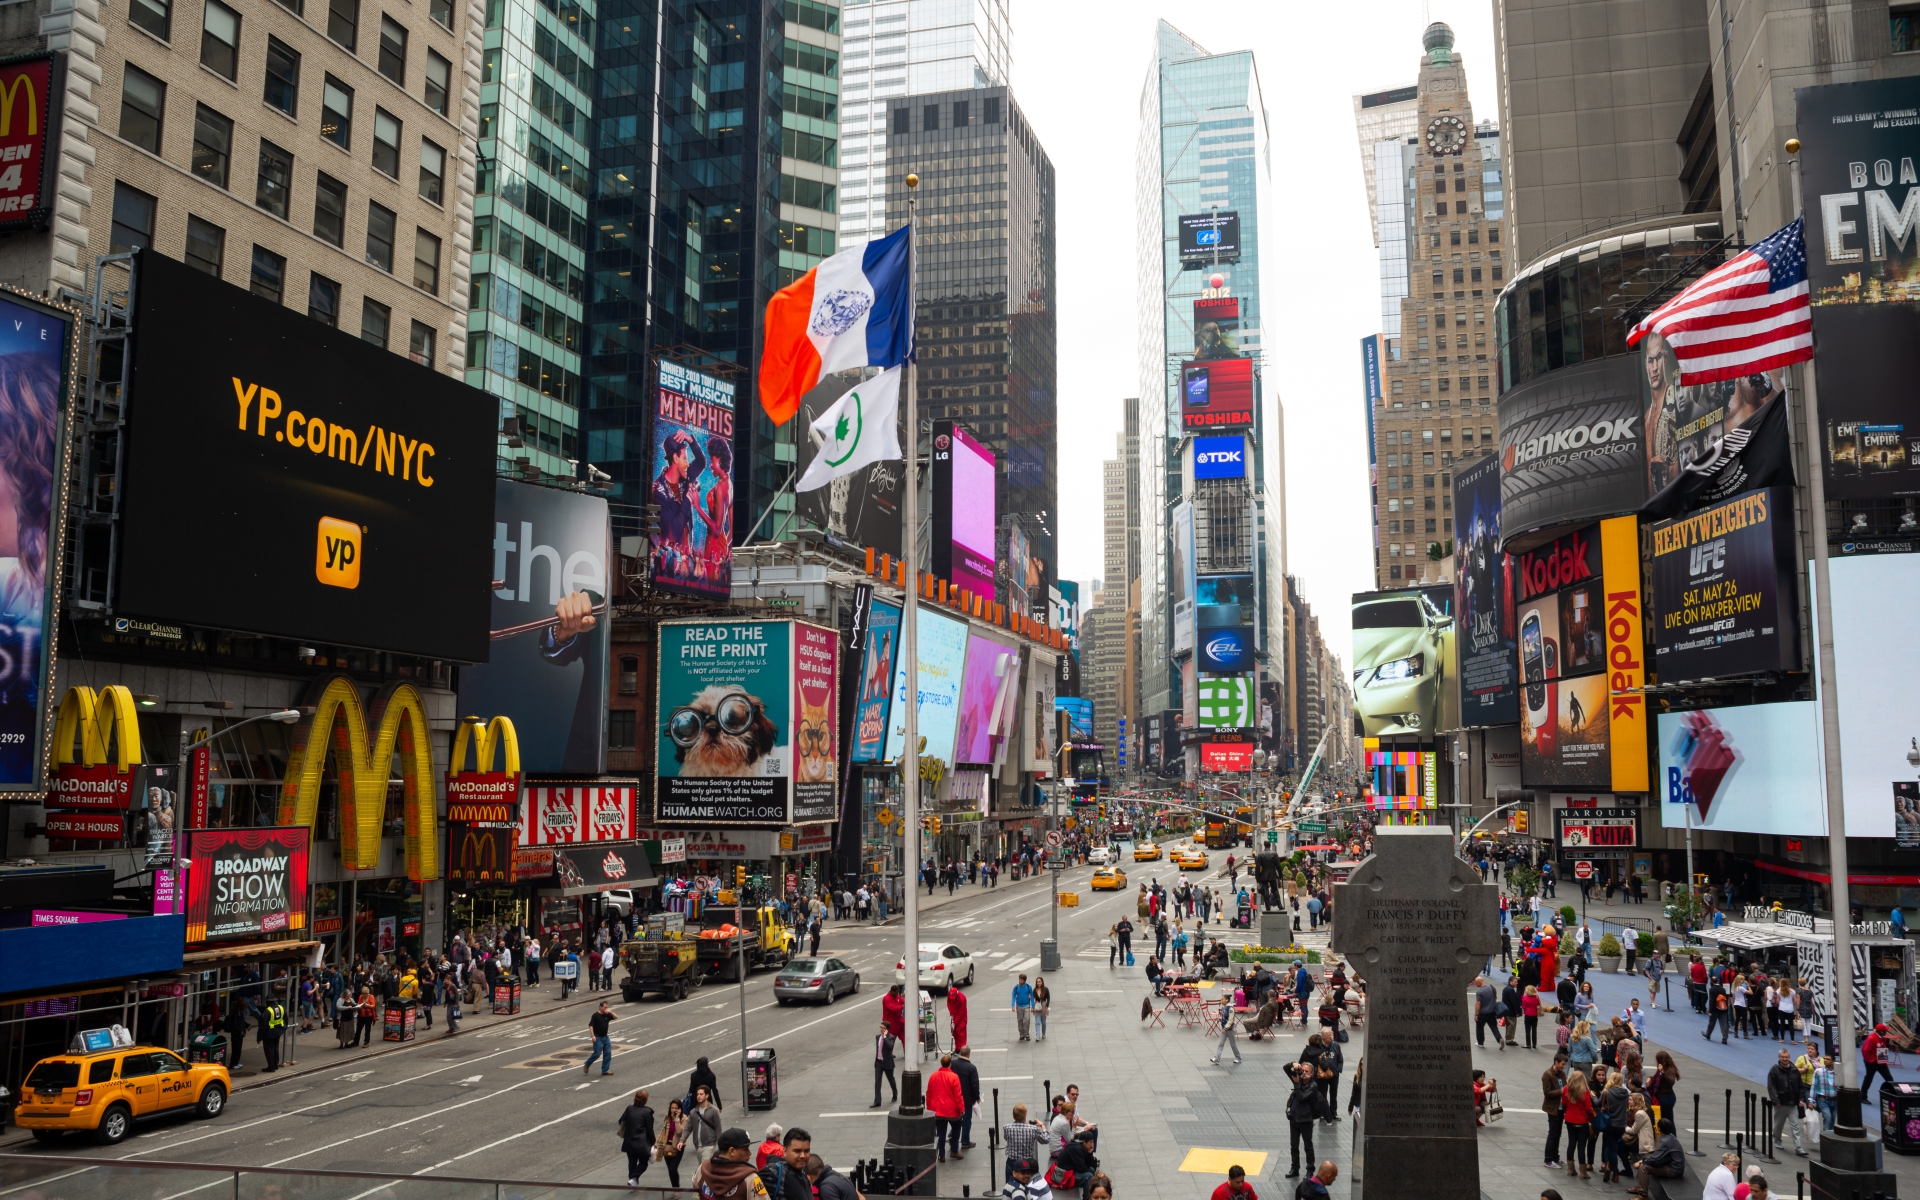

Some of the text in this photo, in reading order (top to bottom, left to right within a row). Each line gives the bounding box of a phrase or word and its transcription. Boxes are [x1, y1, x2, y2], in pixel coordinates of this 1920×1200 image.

[1832, 114, 1853, 124] FROM
[1873, 120, 1888, 129] AND
[0, 144, 32, 162] EN
[1202, 288, 1230, 298] 2012
[1194, 298, 1238, 308] TOSHIBA
[660, 360, 685, 379] WINNER!
[686, 369, 700, 384] 2010
[660, 372, 734, 408] BEST MUSICAL
[660, 391, 733, 436] MEMPHIS
[1185, 411, 1252, 426] TOSHIBA
[231, 376, 436, 488] YP.com/NYC
[1864, 434, 1900, 447] EMPIRE
[936, 452, 948, 460] LG
[1207, 451, 1241, 463] TDK
[1528, 442, 1637, 473] driving emotion
[1486, 460, 1498, 473] DEP
[1722, 473, 1748, 496] FORGOTTEN
[1653, 492, 1767, 557] HEAVYWEIGHTS
[324, 535, 355, 571] yp
[1689, 538, 1726, 577] UFC
[494, 520, 606, 606] the
[1521, 531, 1591, 598] Kodak
[1683, 588, 1700, 607] SAT.
[1703, 583, 1723, 602] MAY
[1724, 579, 1738, 597] 26
[1664, 592, 1762, 630] LIVE ON PAY-PER-VIEW
[1474, 610, 1495, 636] DARK
[685, 626, 763, 642] READ THE
[806, 630, 818, 643] Don't
[1472, 626, 1498, 652] SHADOWS
[681, 643, 768, 658] FINE PRINT
[800, 644, 832, 662] HSUS disguise
[1212, 644, 1242, 652] BL
[1608, 590, 1642, 720] Kodak
[799, 660, 832, 675] itself local
[811, 678, 828, 690] shelter.
[864, 702, 882, 721] MARY
[858, 717, 884, 738] POPPINS
[48, 778, 128, 793] McDonald's
[448, 781, 515, 793] McDonald's
[59, 794, 113, 804] Restaurant
[196, 793, 204, 830] HOURS
[662, 806, 783, 818] HUMANEWATCH.ORG
[794, 806, 834, 816] HUMANEWATCH.ORG
[47, 822, 119, 832] OPEN 24 HOURS
[1592, 826, 1632, 845] EVITA
[517, 850, 552, 864] ameras
[214, 856, 288, 876] BROADWAY
[216, 872, 285, 902] SHOW
[214, 897, 286, 916] INFORMATION
[35, 914, 79, 924] TIMES SQUARE
[1367, 910, 1468, 920] FRANCIS DUFFY
[1786, 912, 1812, 928] HOT DOGS
[1380, 936, 1420, 944] CATHOLIC
[174, 1080, 192, 1092] TAXI
